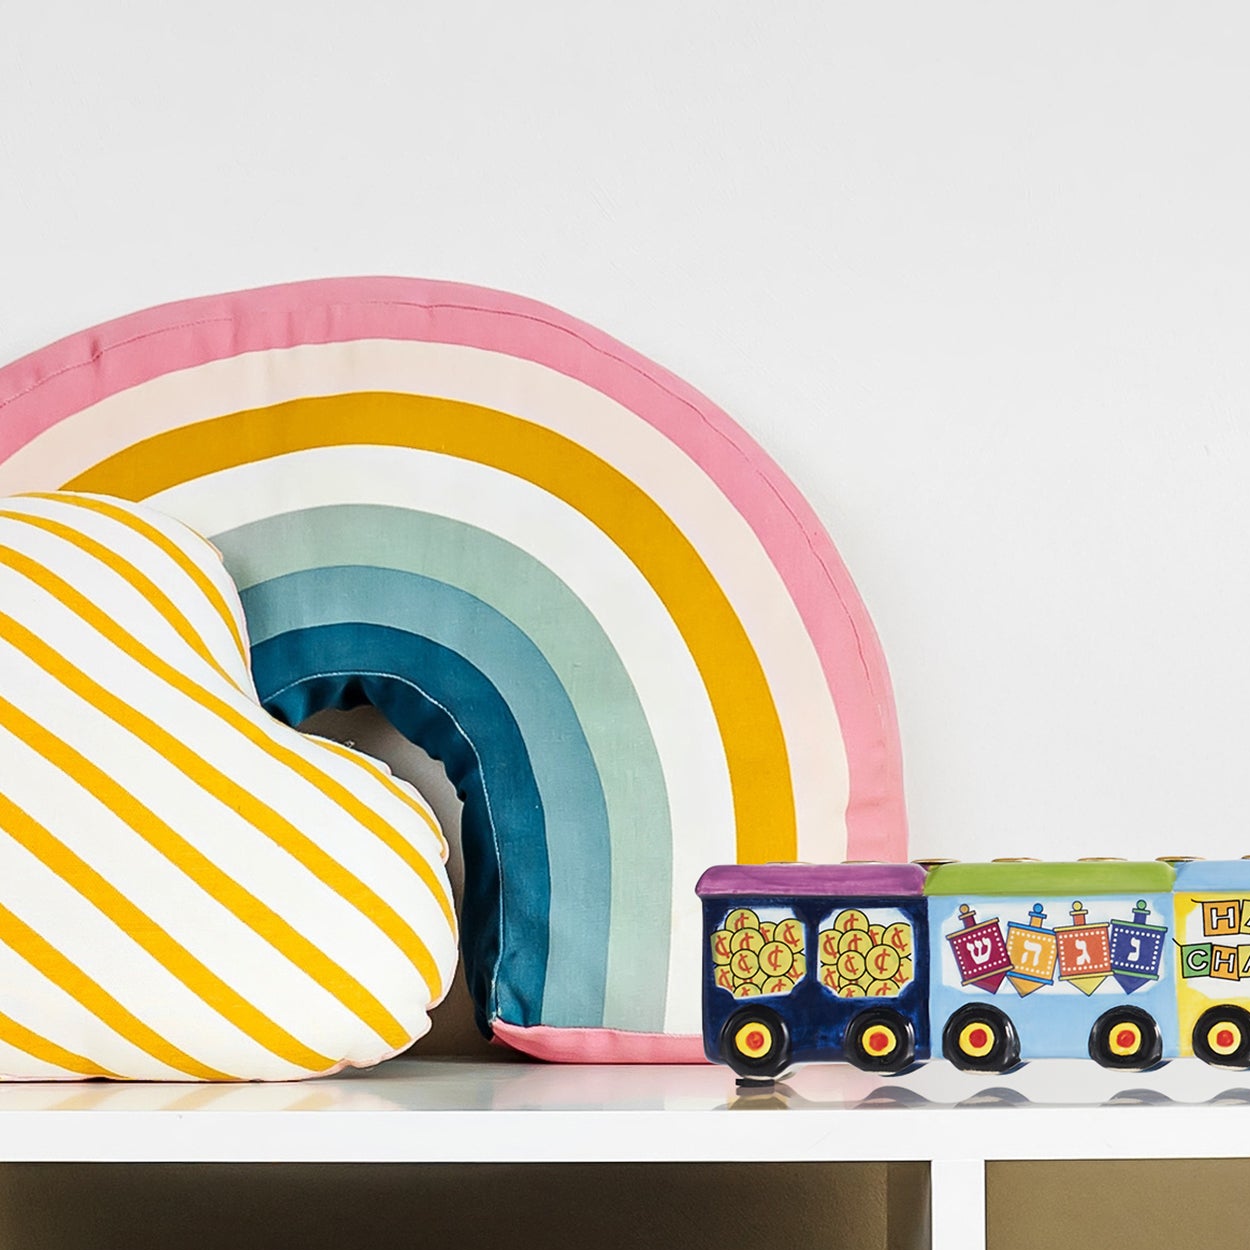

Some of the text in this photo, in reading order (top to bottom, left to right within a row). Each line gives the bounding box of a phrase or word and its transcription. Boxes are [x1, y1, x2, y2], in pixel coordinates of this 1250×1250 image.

[966, 937, 992, 965] ש
[1021, 939, 1043, 967] ה
[1074, 939, 1091, 966] ג
[1127, 937, 1141, 962] נ
